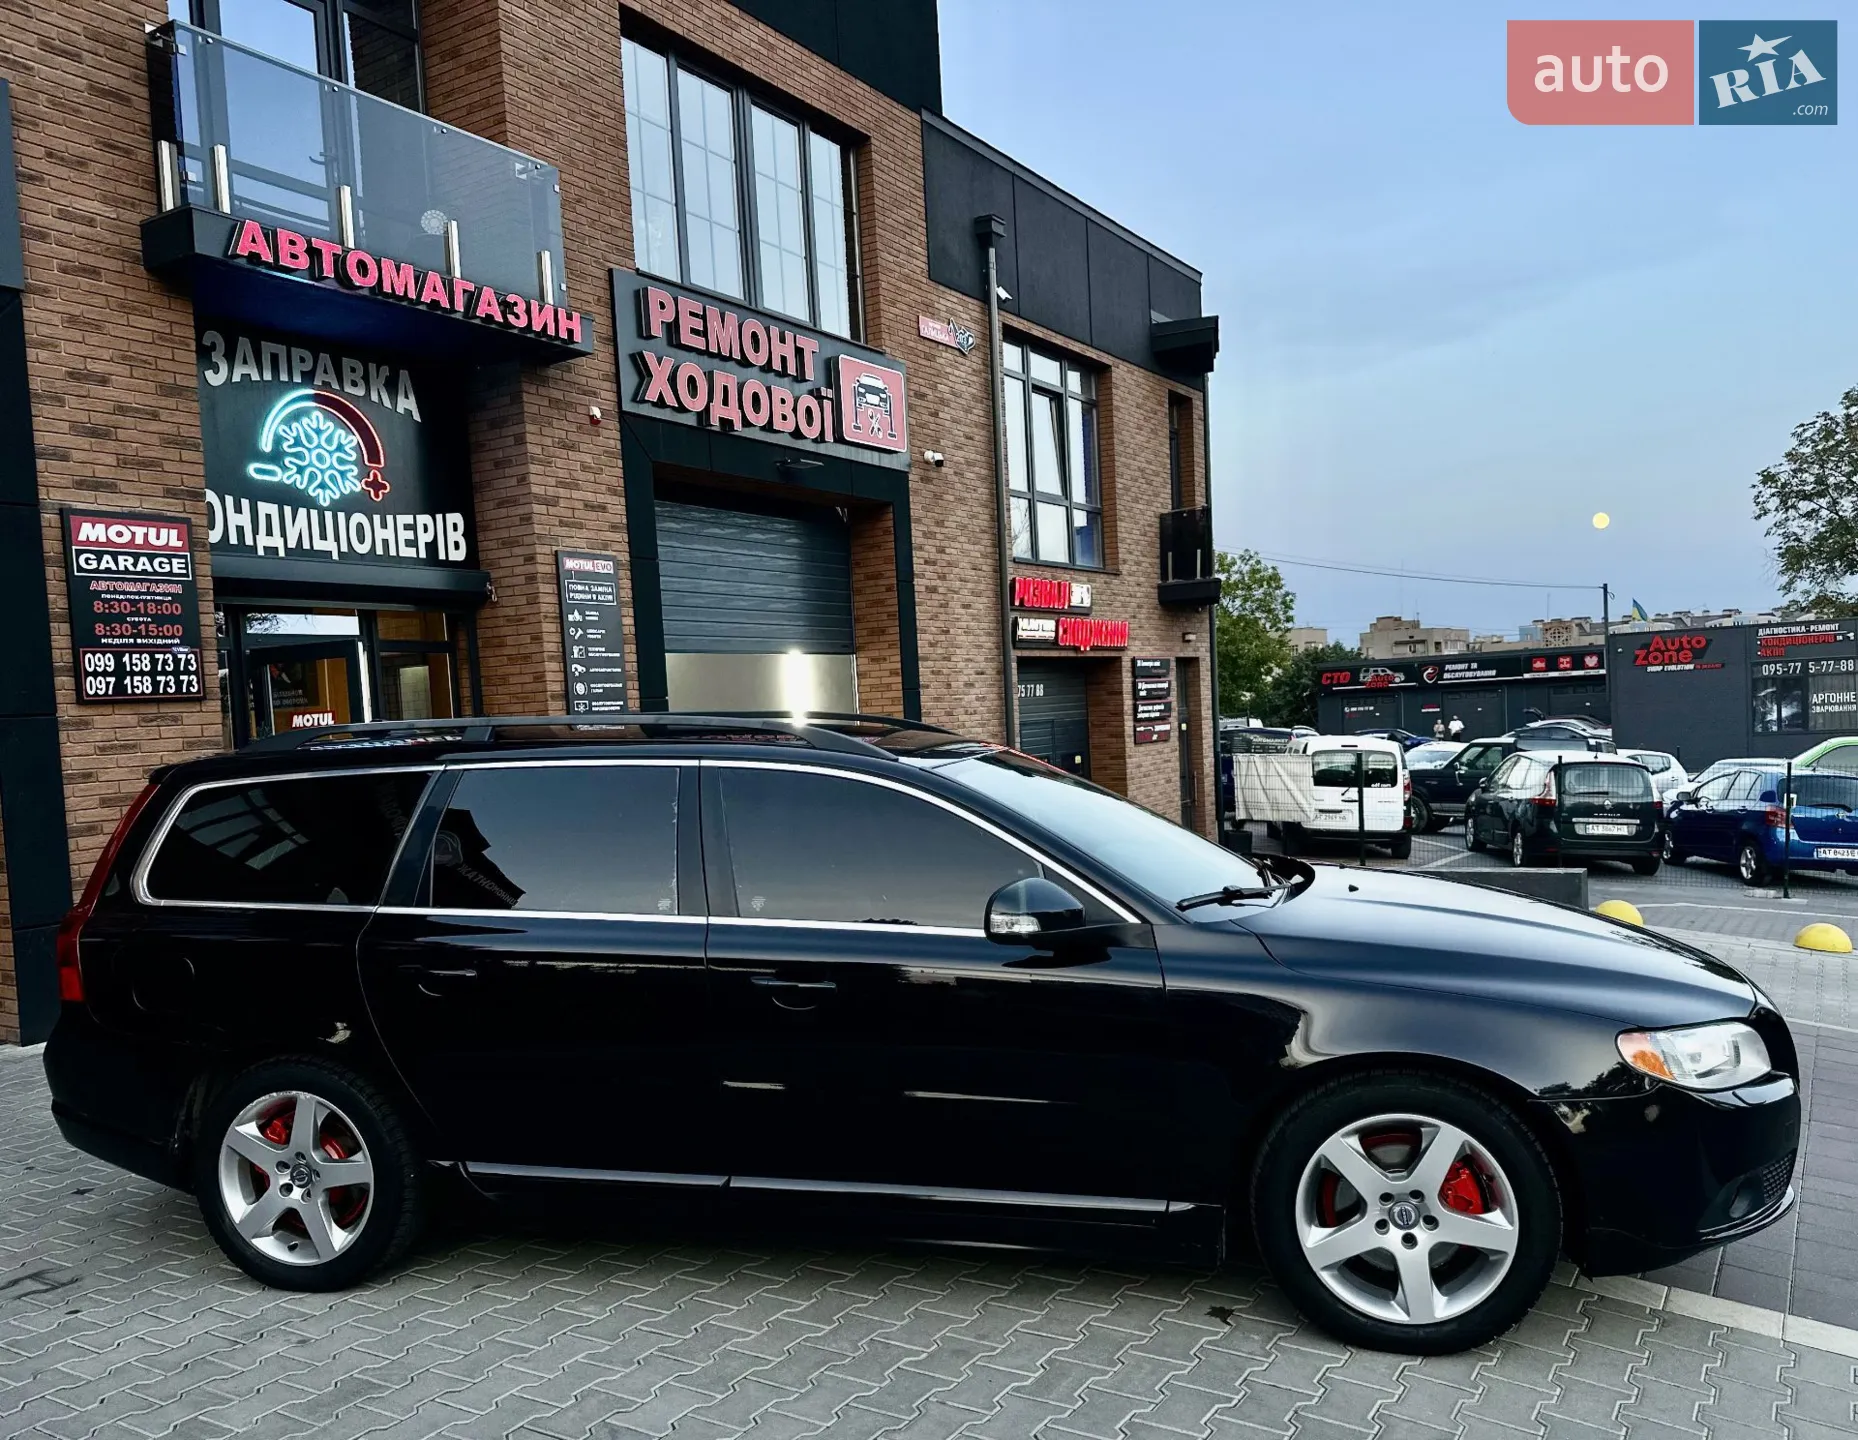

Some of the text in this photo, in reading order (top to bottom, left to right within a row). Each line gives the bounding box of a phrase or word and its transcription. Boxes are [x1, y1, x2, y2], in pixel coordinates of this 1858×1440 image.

[235, 219, 583, 343] АВТОМАГАЗИН
[644, 286, 820, 381] РЕМОНТ
[202, 330, 421, 423] ЗАПРАВКА
[638, 350, 834, 443] ХОДОВОЇ
[205, 488, 467, 561] ОНДИЦІОНЕРІВ
[77, 522, 183, 548] MOTUL
[78, 553, 187, 574] GARAGE
[564, 558, 612, 572] MOTUL EVO
[89, 580, 183, 594] АВТОМАГАЗИН
[1014, 576, 1070, 610] РОЗВАЛ
[93, 600, 182, 615] 8:30-18:00
[94, 623, 183, 637] 8:30-15:00
[1058, 617, 1130, 651] СХОДЖЕННЯ
[101, 637, 181, 645] НЕДІЛЯ ВИХІДНИЙ
[1649, 634, 1707, 652] Auto
[1761, 634, 1835, 647] КОНДИЦІОНЕРІВ
[1634, 649, 1693, 666] Zone
[1760, 647, 1785, 657] АКПП
[84, 652, 198, 673] 099 158 73 73
[1445, 663, 1469, 671] РЕМОНТ
[1762, 659, 1855, 676] 095-77 5-77-88
[86, 674, 199, 696] 097 158 73 73
[1321, 671, 1351, 685] СТО
[1370, 673, 1395, 682] Auto
[1026, 684, 1035, 697] 77
[1811, 691, 1857, 704] АРГОННЕ
[1811, 704, 1857, 713] ЗВАРЮВАННЯ
[292, 713, 335, 728] MOTUL
